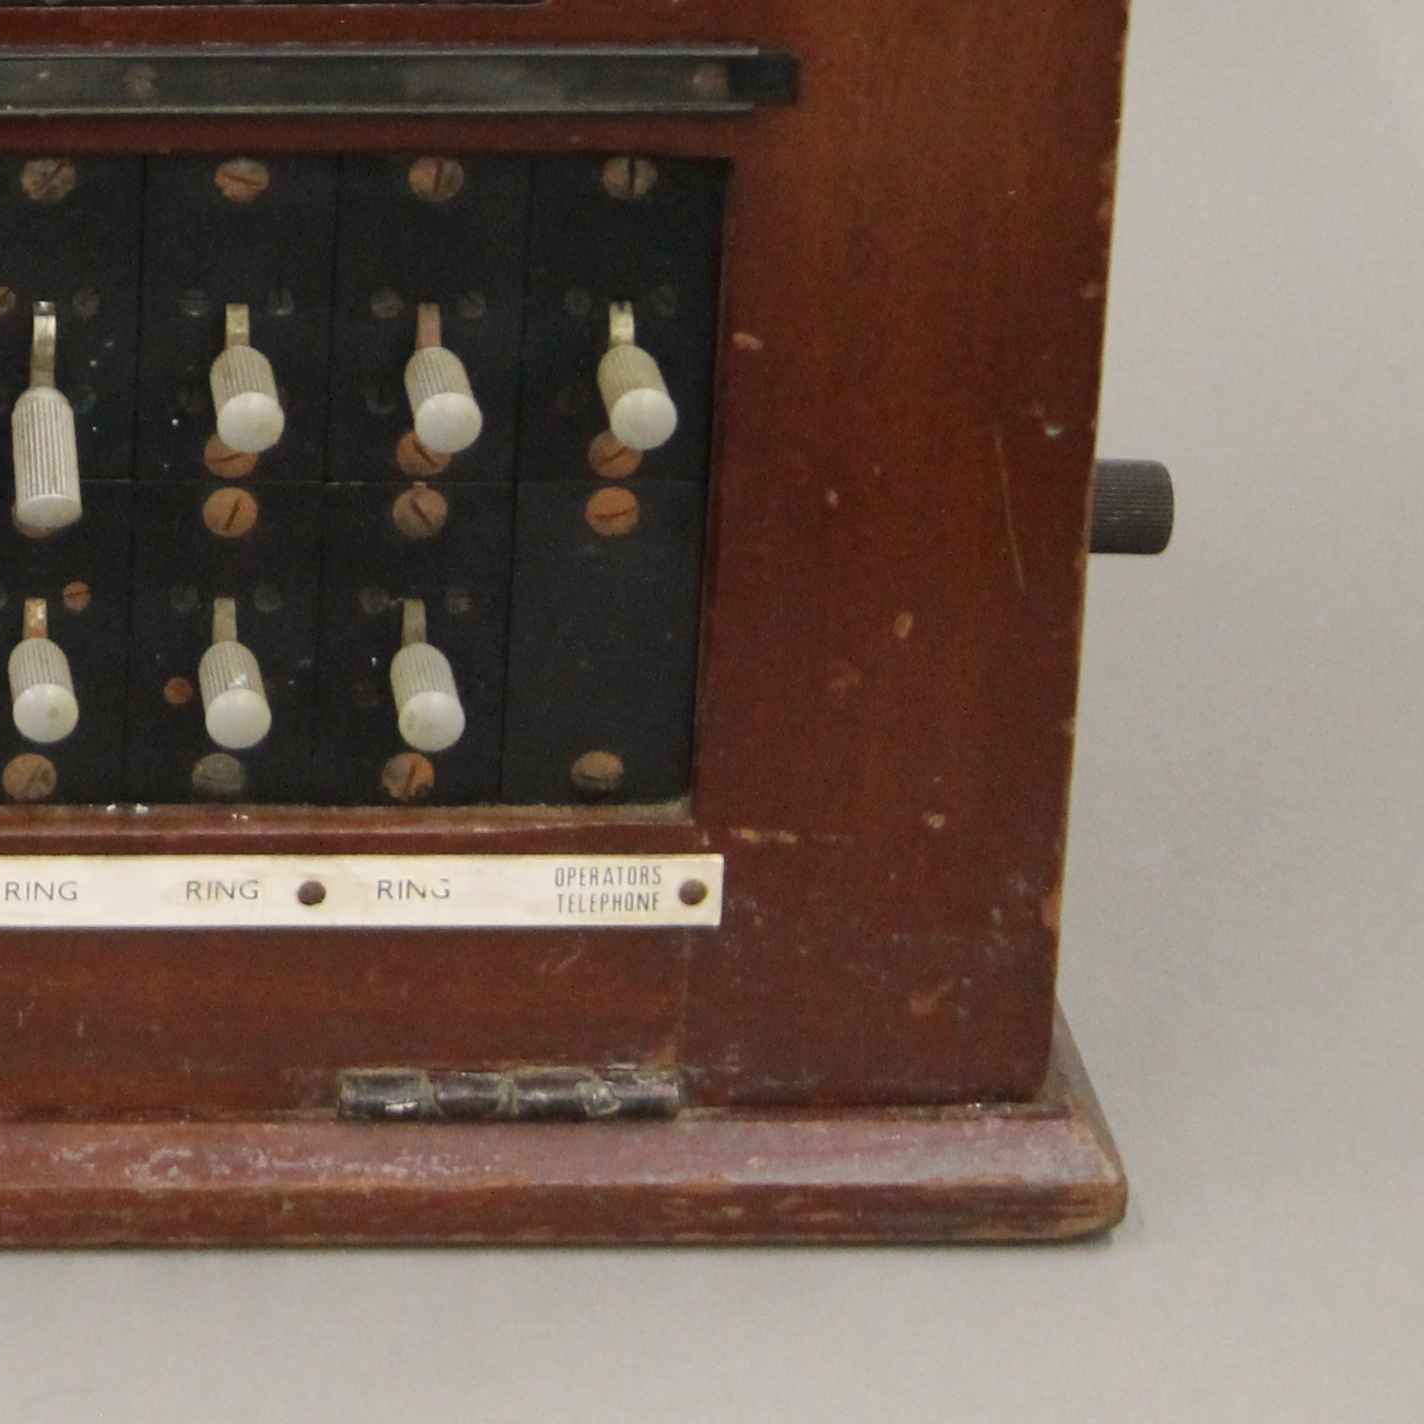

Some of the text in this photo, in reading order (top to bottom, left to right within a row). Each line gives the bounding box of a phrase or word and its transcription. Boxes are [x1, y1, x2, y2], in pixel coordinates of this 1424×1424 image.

[554, 865, 663, 887] OPERATORS
[4, 880, 79, 902] RING
[185, 879, 261, 901] RING
[376, 878, 451, 900] RING
[557, 891, 661, 914] TELEPHONE
